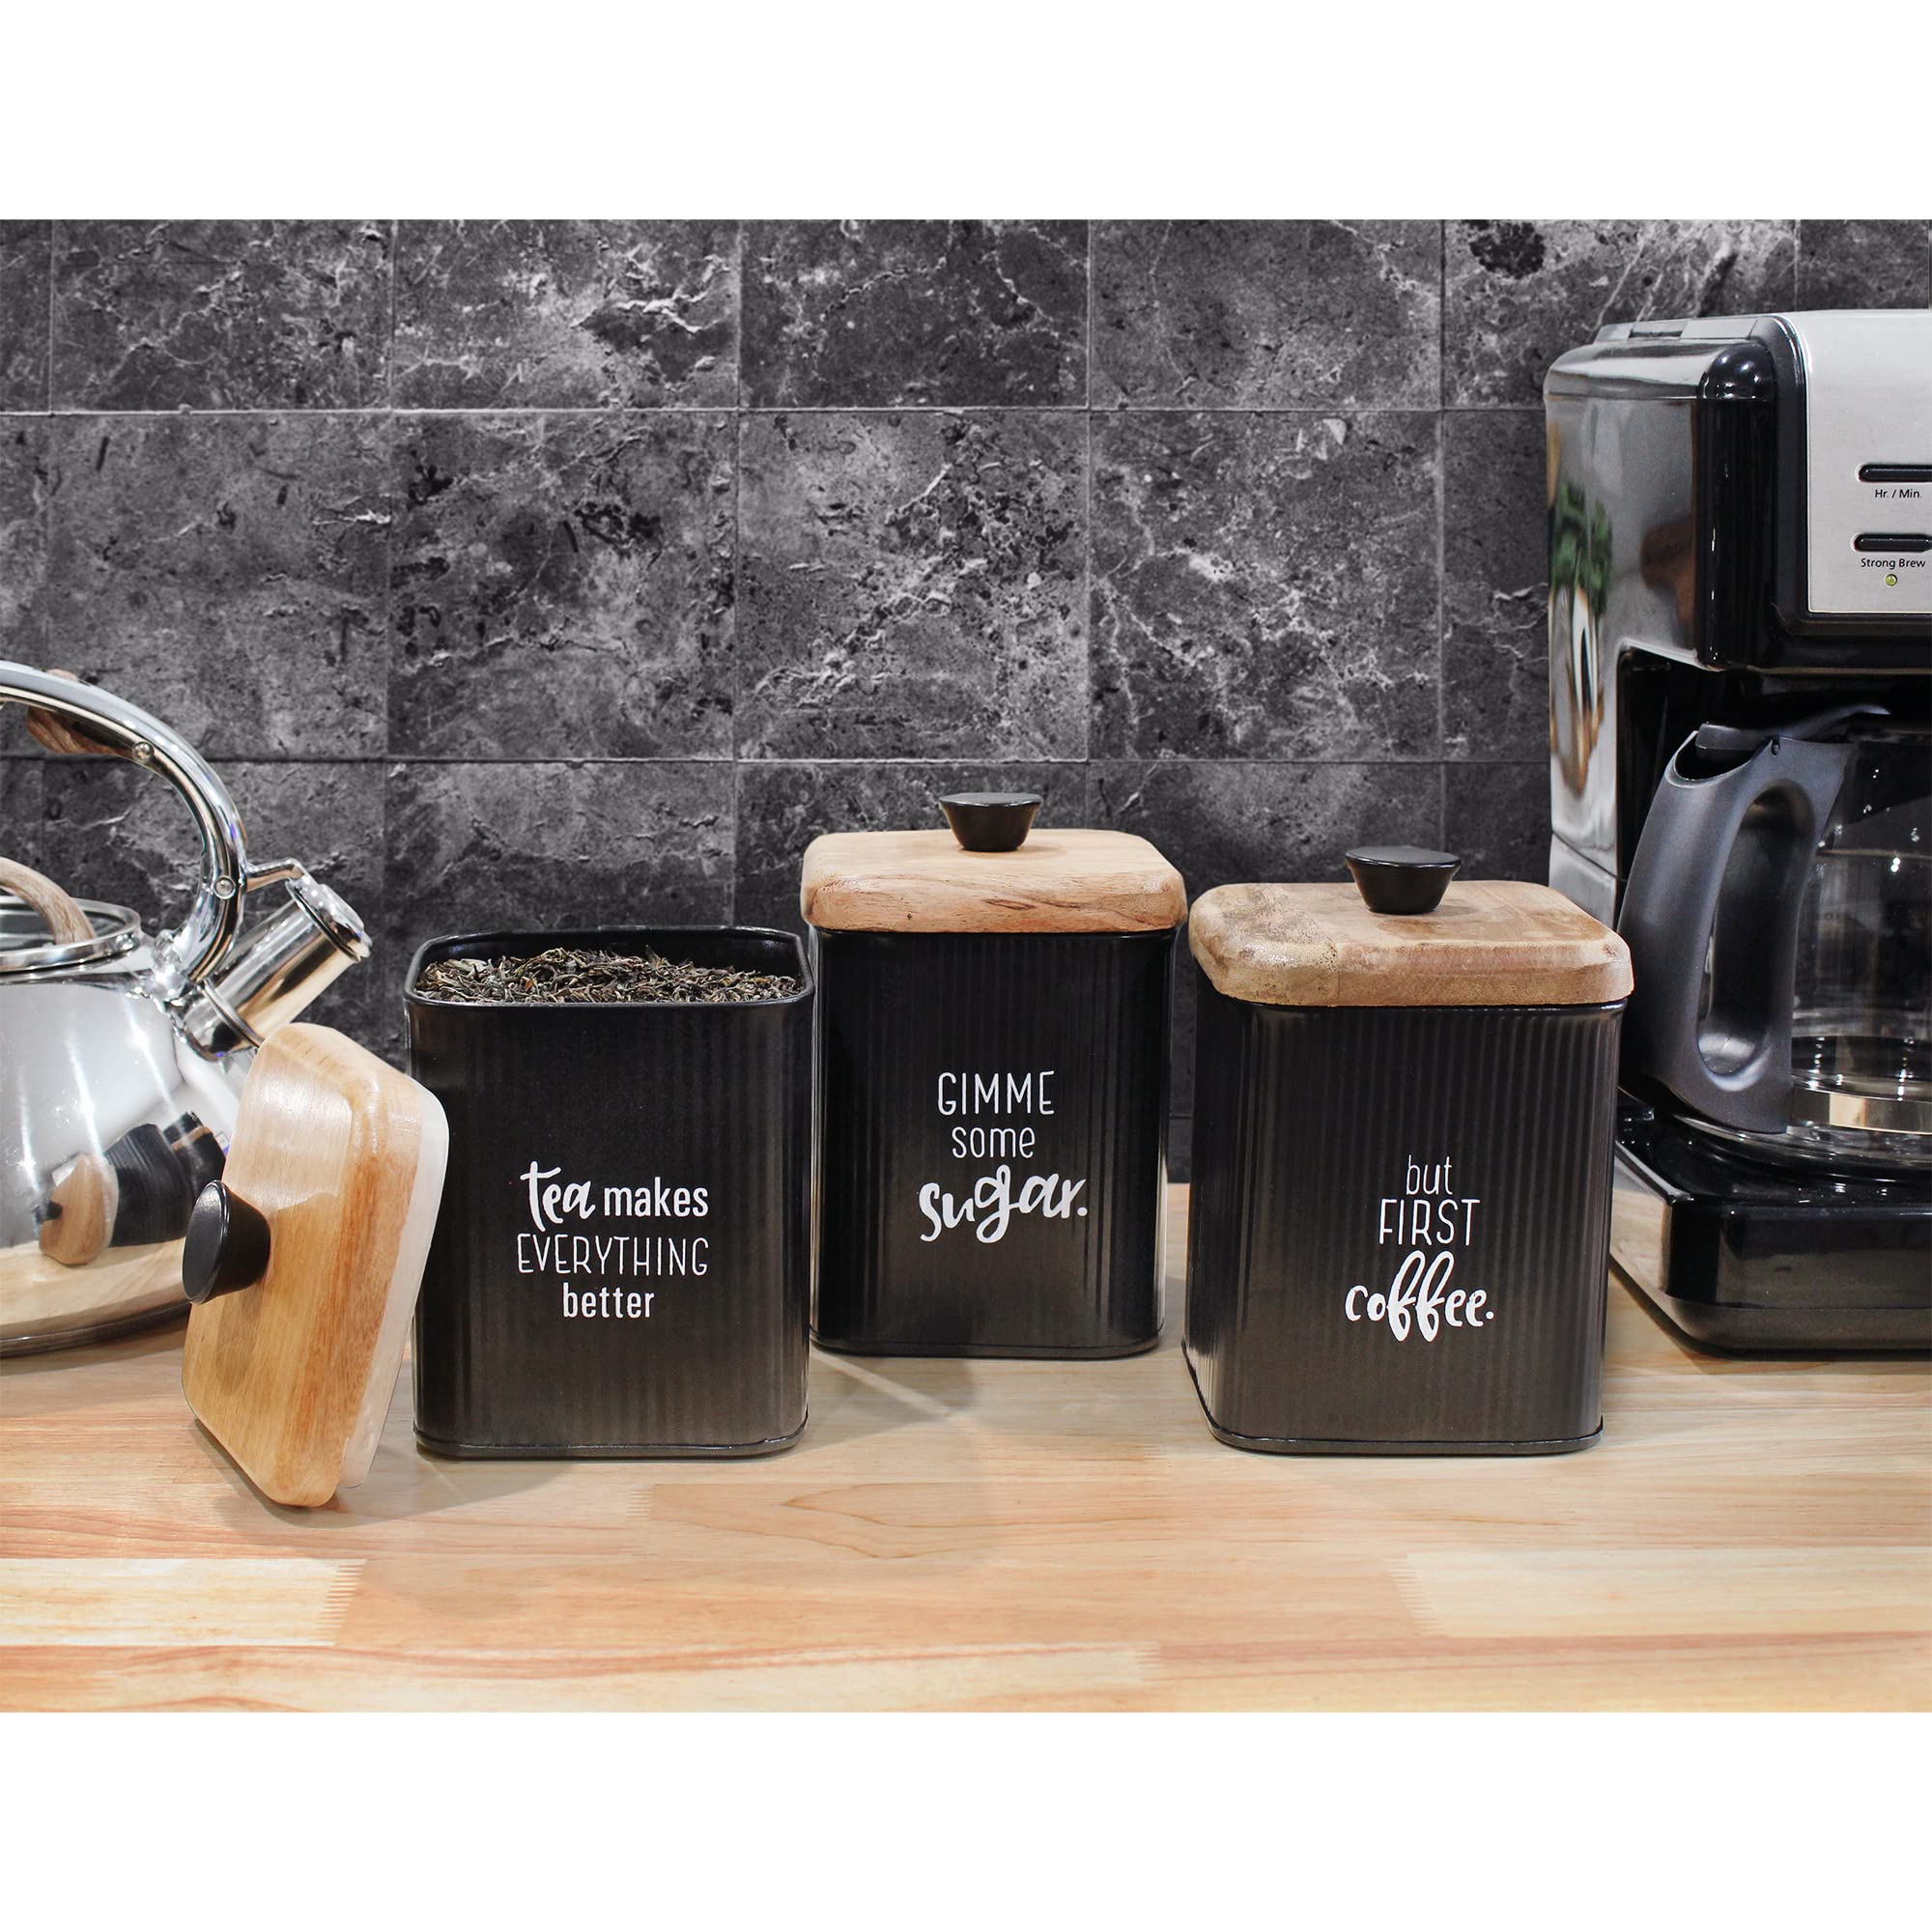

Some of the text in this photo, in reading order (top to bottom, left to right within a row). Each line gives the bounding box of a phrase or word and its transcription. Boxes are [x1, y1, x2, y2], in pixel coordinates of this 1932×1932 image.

[1898, 488, 1923, 498] Min.
[1861, 557, 1926, 570] Strong Brew
[937, 1070, 1055, 1115] GIMME
[952, 1126, 1036, 1159] some
[519, 1160, 709, 1232] tea makes
[1406, 1154, 1453, 1195] but
[919, 1164, 1088, 1244] sugar.
[1378, 1198, 1481, 1246] FIRST
[517, 1233, 709, 1276] EVERYTHING
[562, 1282, 655, 1319] better
[1345, 1249, 1494, 1343] coffee.
